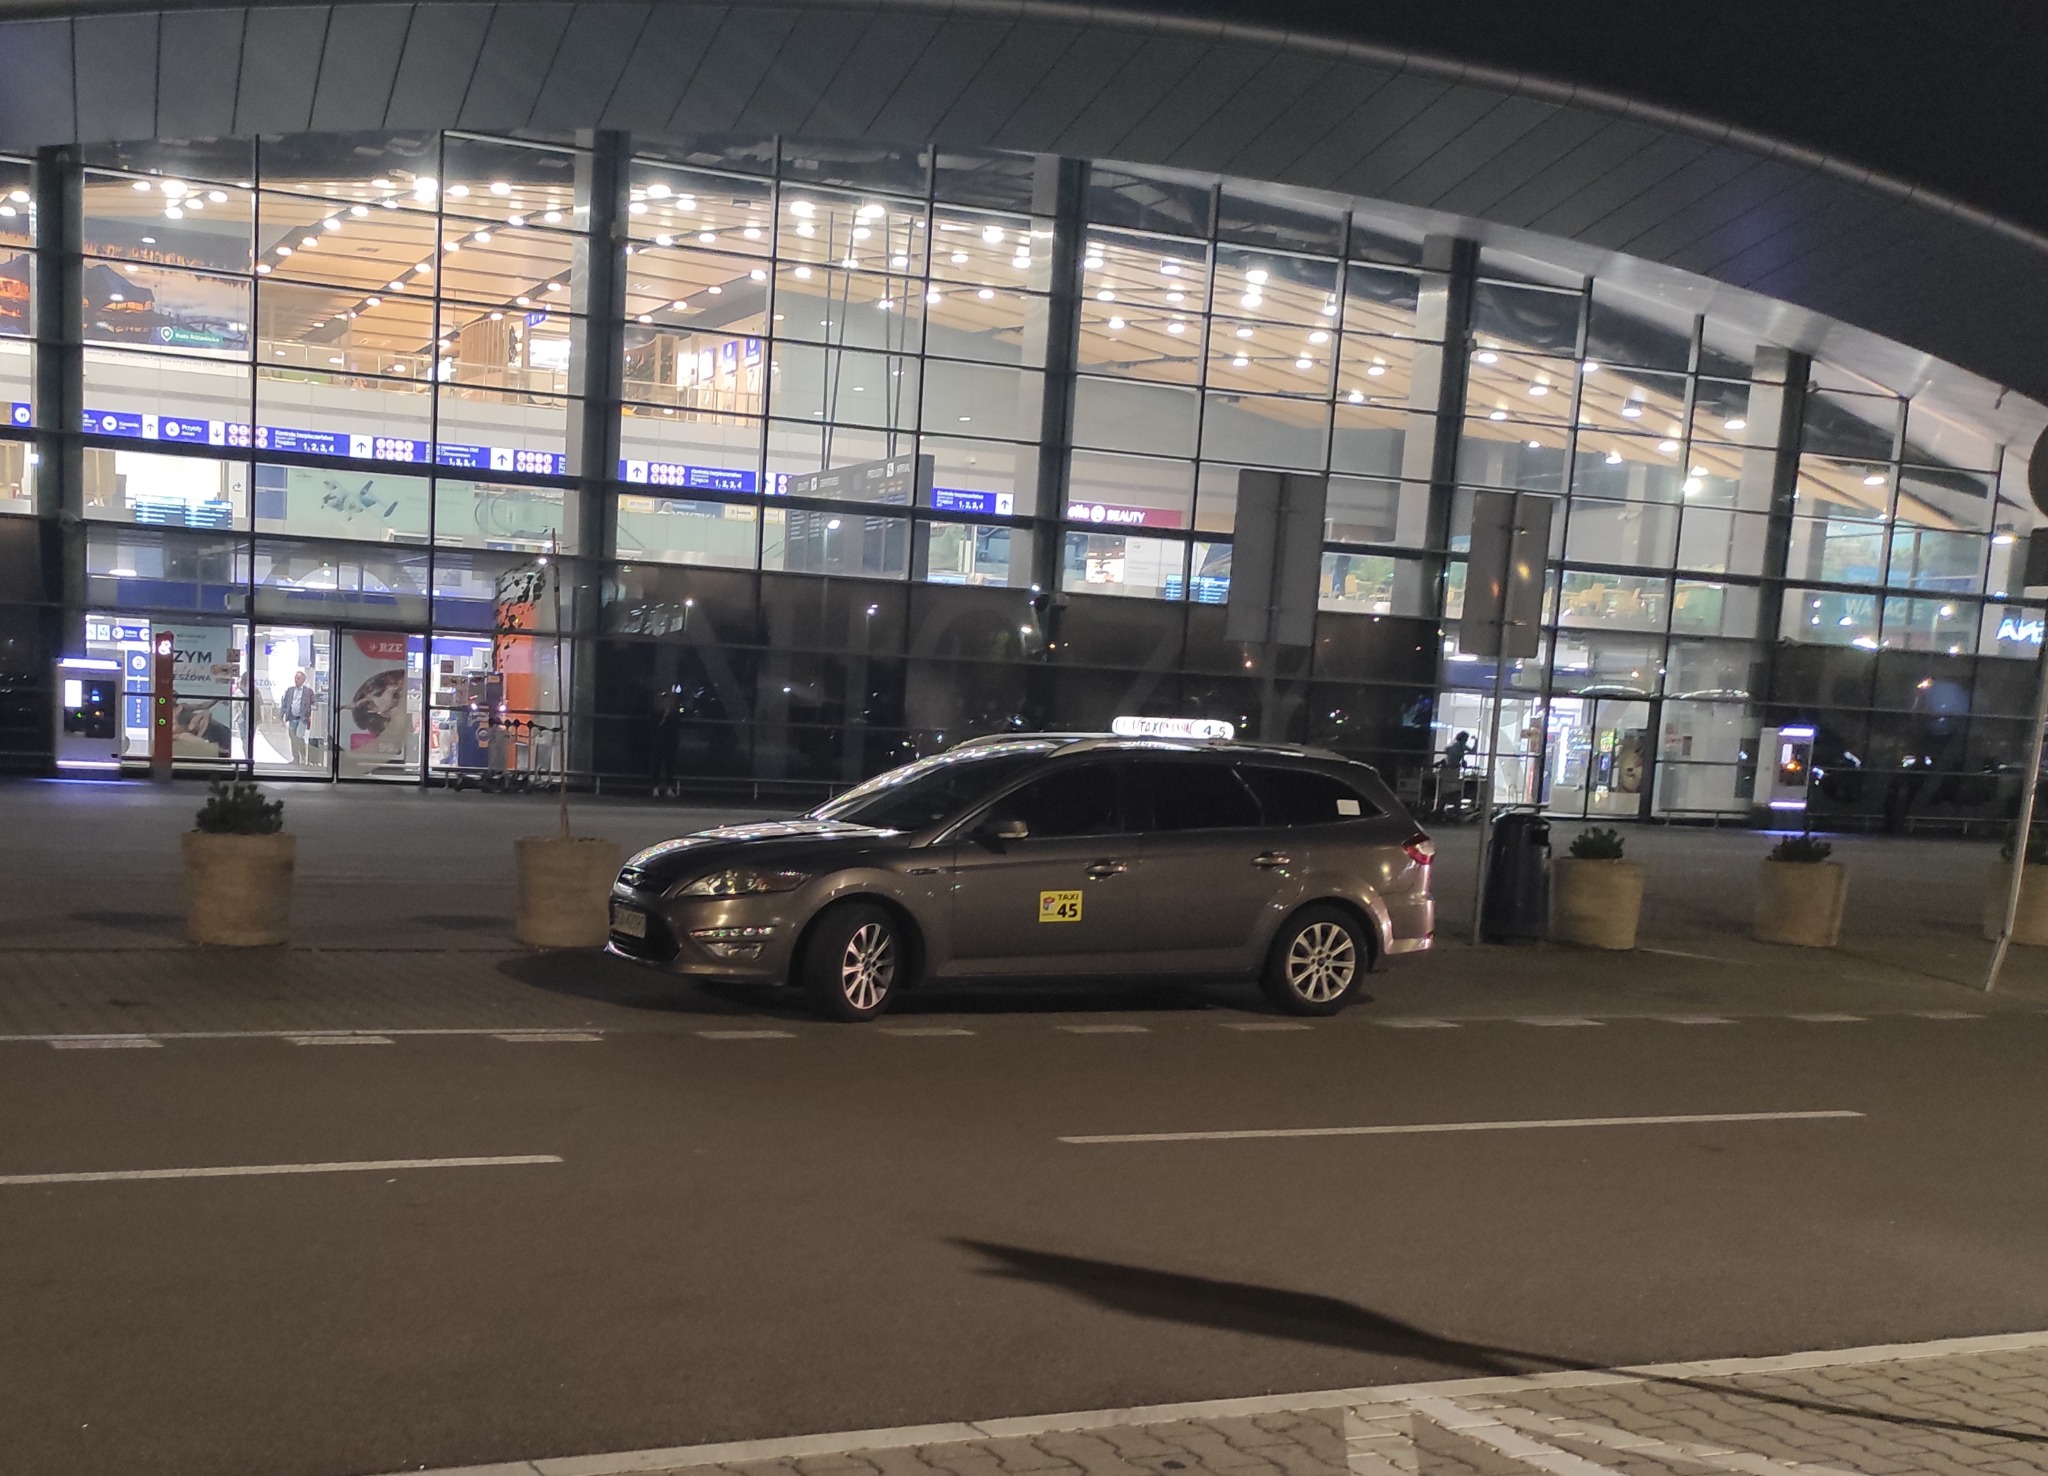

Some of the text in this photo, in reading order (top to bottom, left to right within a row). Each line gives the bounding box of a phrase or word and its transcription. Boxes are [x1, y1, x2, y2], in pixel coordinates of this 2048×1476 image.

[1106, 509, 1146, 524] BEAUTY
[173, 650, 212, 663] ZYM
[1057, 893, 1079, 901] TAXI
[1056, 903, 1078, 918] 45
